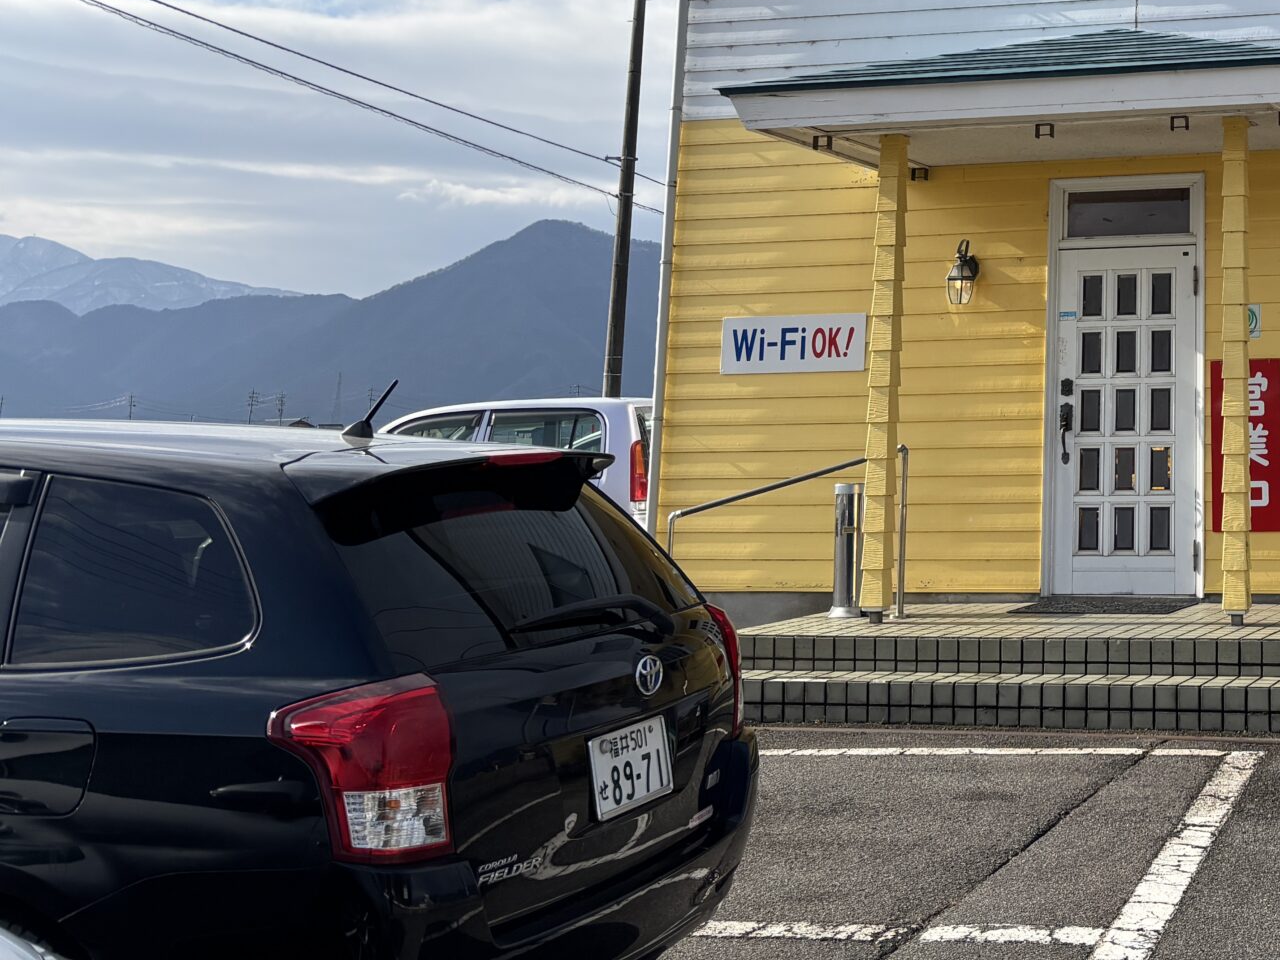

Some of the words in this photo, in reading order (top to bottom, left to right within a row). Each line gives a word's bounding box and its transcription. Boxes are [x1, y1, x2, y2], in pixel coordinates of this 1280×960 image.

[611, 748, 664, 806] 89-71
[477, 856, 543, 888] FIELDER
[478, 853, 518, 873] COROLLA
